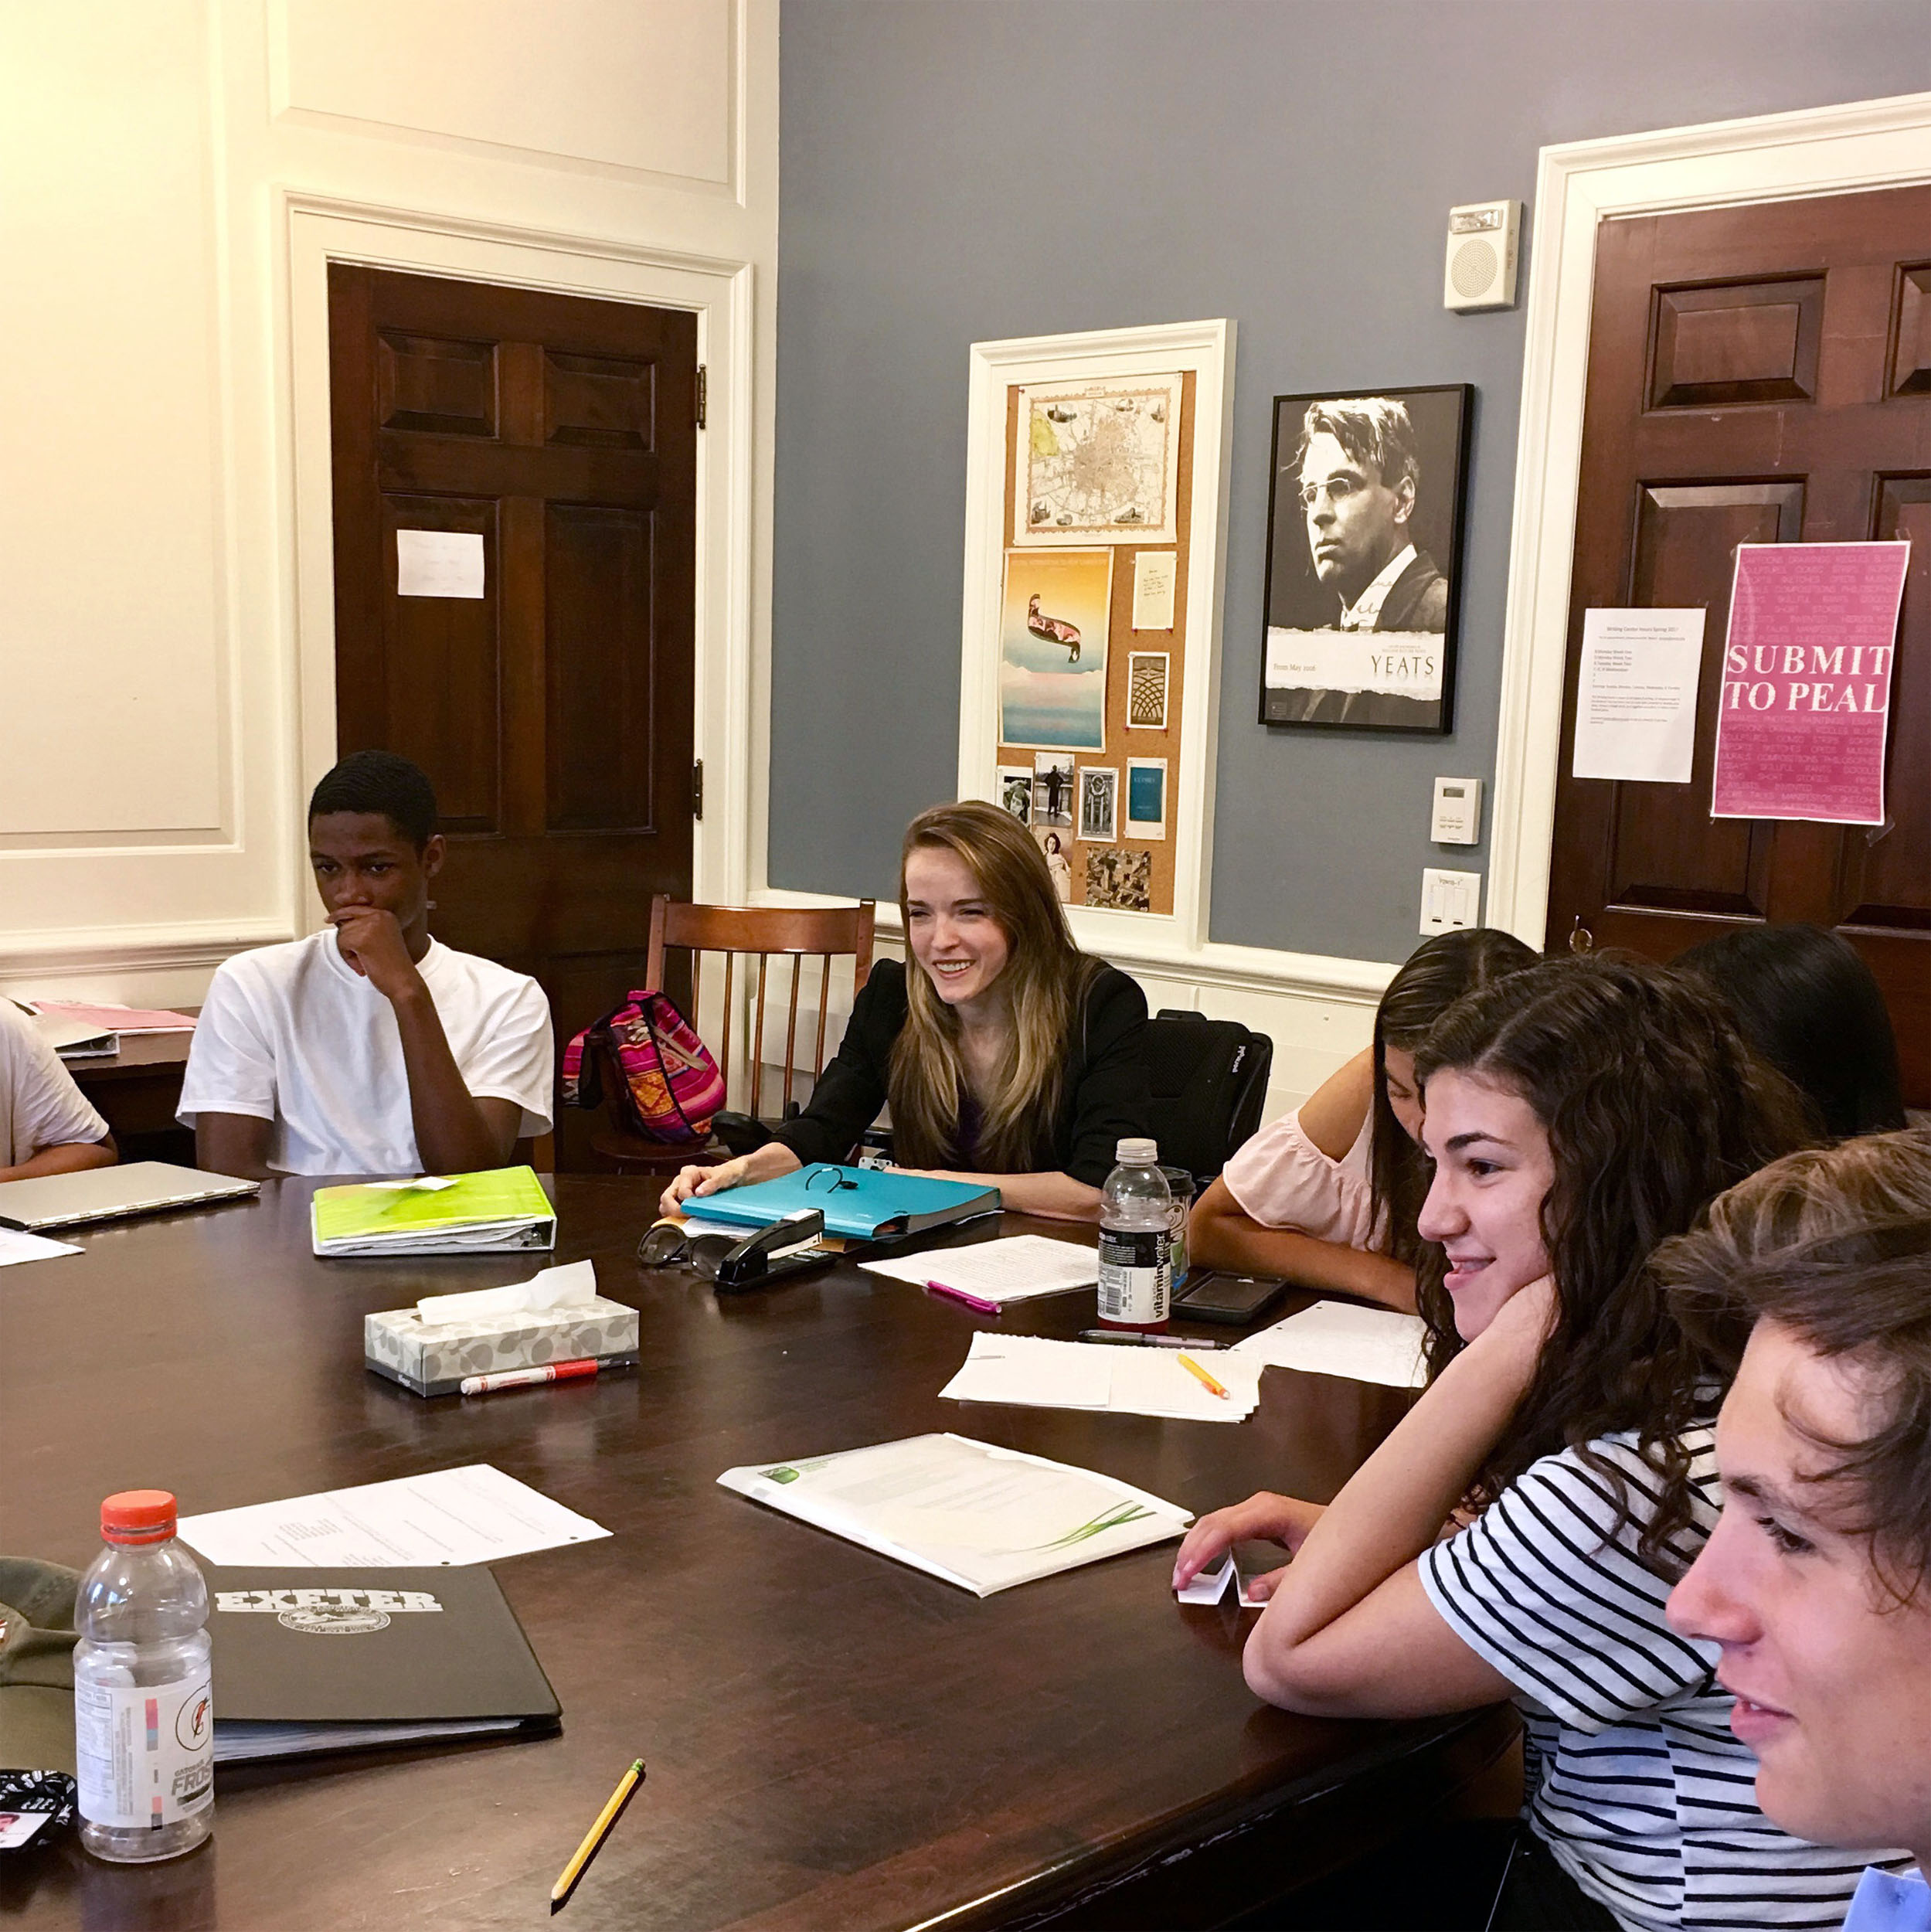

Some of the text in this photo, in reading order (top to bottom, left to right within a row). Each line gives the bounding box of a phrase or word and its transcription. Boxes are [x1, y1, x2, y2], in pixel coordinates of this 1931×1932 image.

[1273, 662, 1289, 671] From
[1290, 663, 1301, 672] May
[1371, 655, 1434, 675] YEATS
[1727, 645, 1892, 675] SUBMIT
[1725, 681, 1886, 713] TO PEAL
[1153, 1234, 1164, 1318] vitaminwater
[215, 1589, 444, 1611] EXETER
[171, 1760, 212, 1796] FROS
